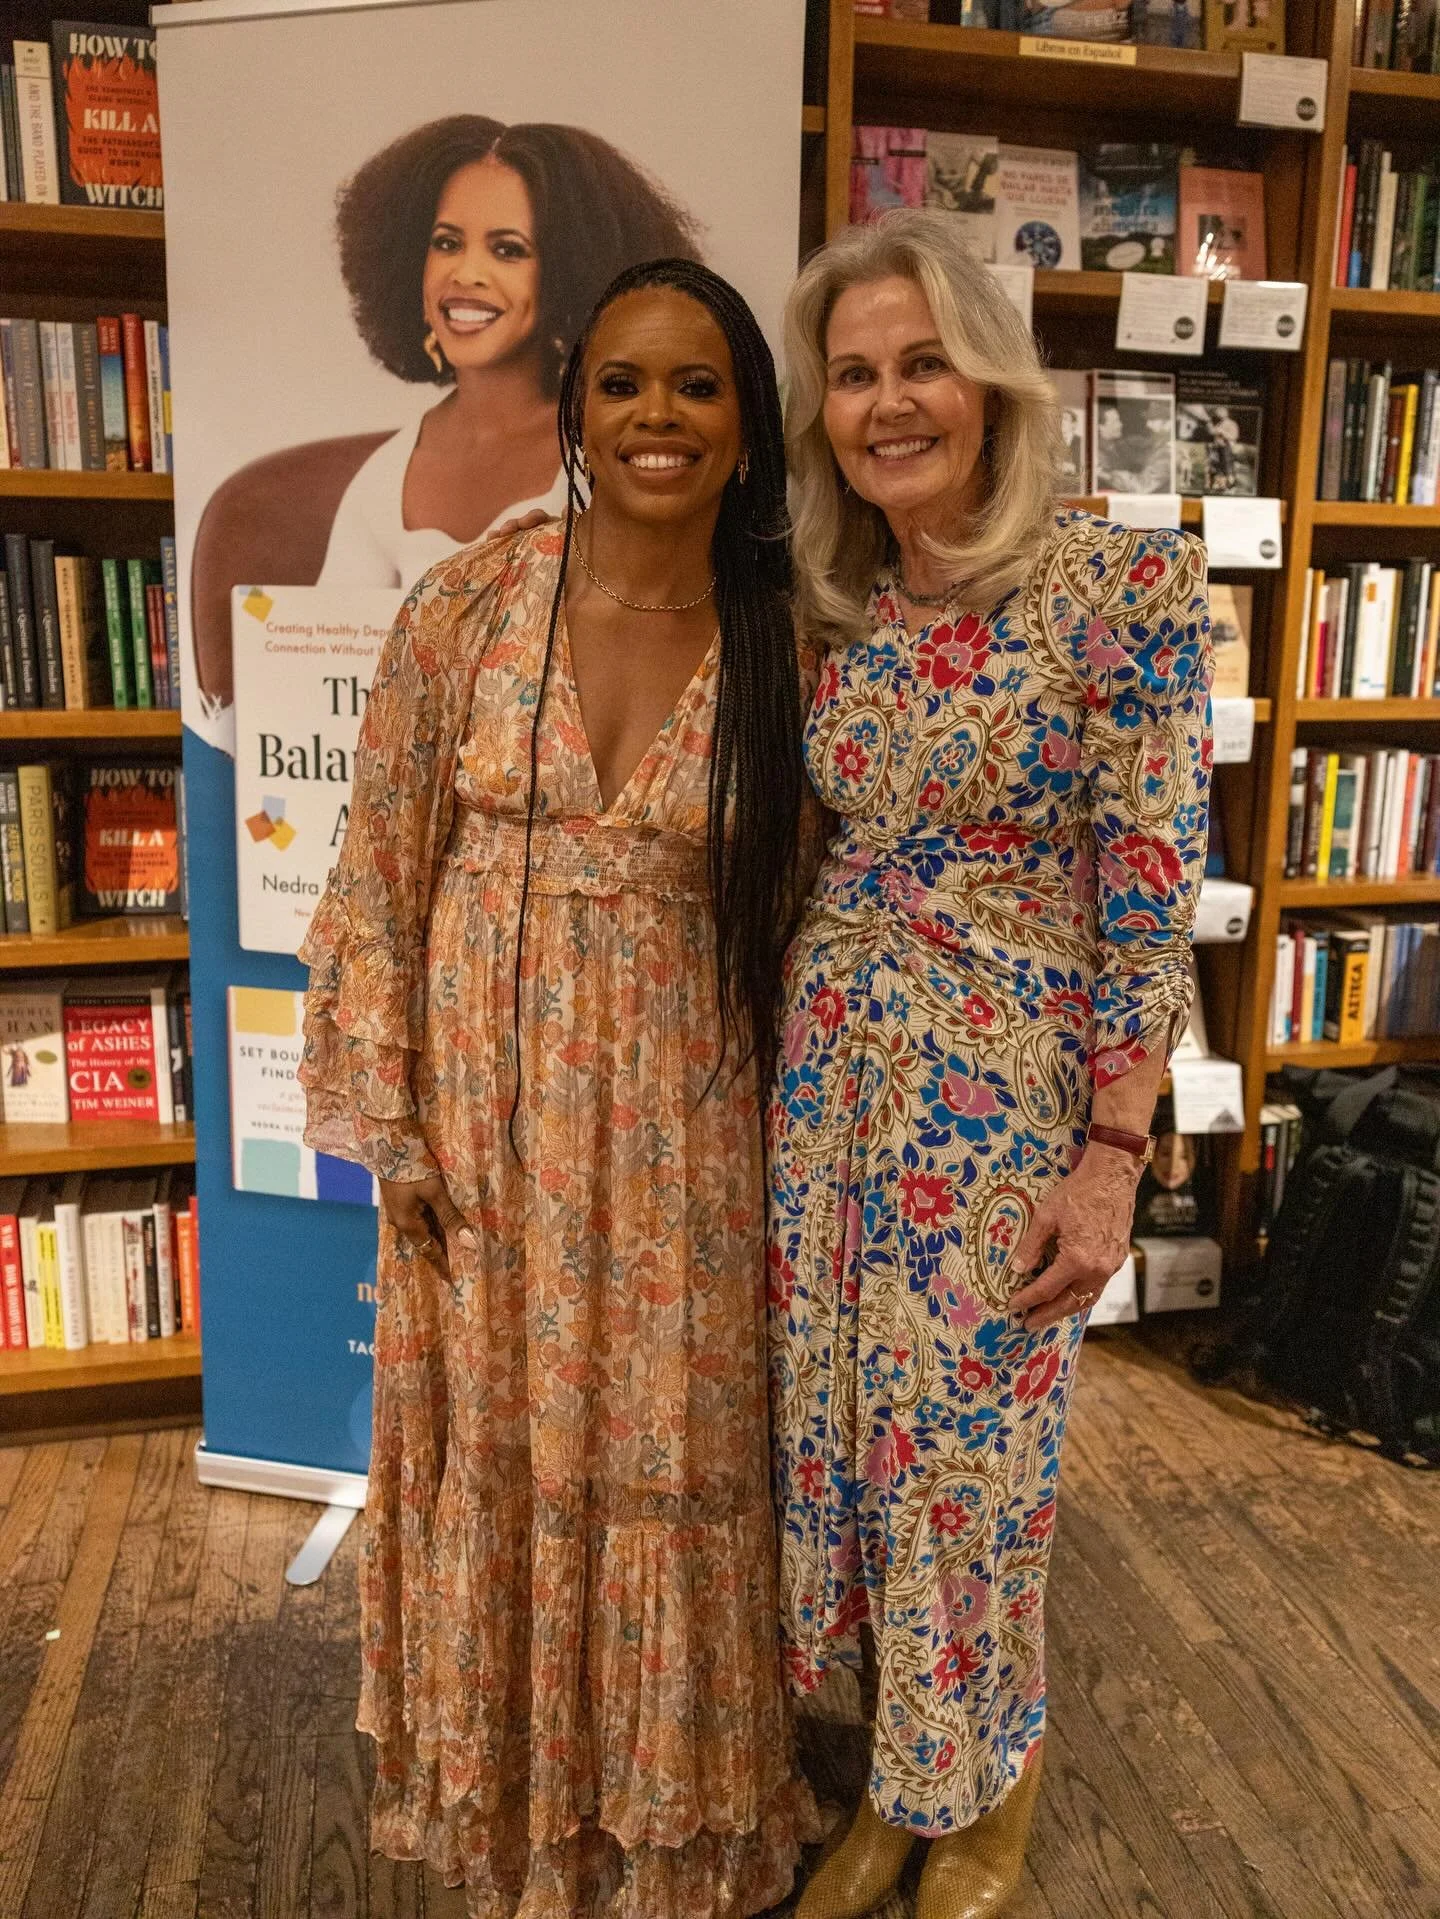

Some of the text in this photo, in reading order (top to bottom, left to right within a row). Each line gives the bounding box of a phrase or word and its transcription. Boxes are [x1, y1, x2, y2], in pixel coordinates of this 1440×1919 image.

[70, 33, 128, 59] HOW
[84, 108, 158, 134] KILL A
[85, 182, 163, 208] WITCH
[164, 546, 175, 587] ISLAM
[266, 622, 313, 637] Creating
[316, 624, 360, 639] Healthy
[264, 640, 374, 656] Connection Without
[22, 659, 32, 693] Freedom
[47, 660, 58, 694] Freedom
[323, 676, 371, 716] Th
[258, 733, 356, 782] Bala
[90, 768, 176, 787] HOW TO
[100, 829, 164, 846] KILL A
[262, 874, 320, 896] Nedra
[96, 888, 166, 908] WITCH
[1348, 963, 1364, 1020] ATTICA
[68, 1019, 149, 1035] LEGACY
[67, 1036, 151, 1052] of ASHES
[240, 1045, 300, 1062] SET BOU
[72, 1059, 87, 1068] The
[261, 1066, 294, 1082] FIND
[70, 1070, 124, 1094] CIA
[74, 1098, 98, 1110] TIM
[102, 1096, 154, 1108] WEINER
